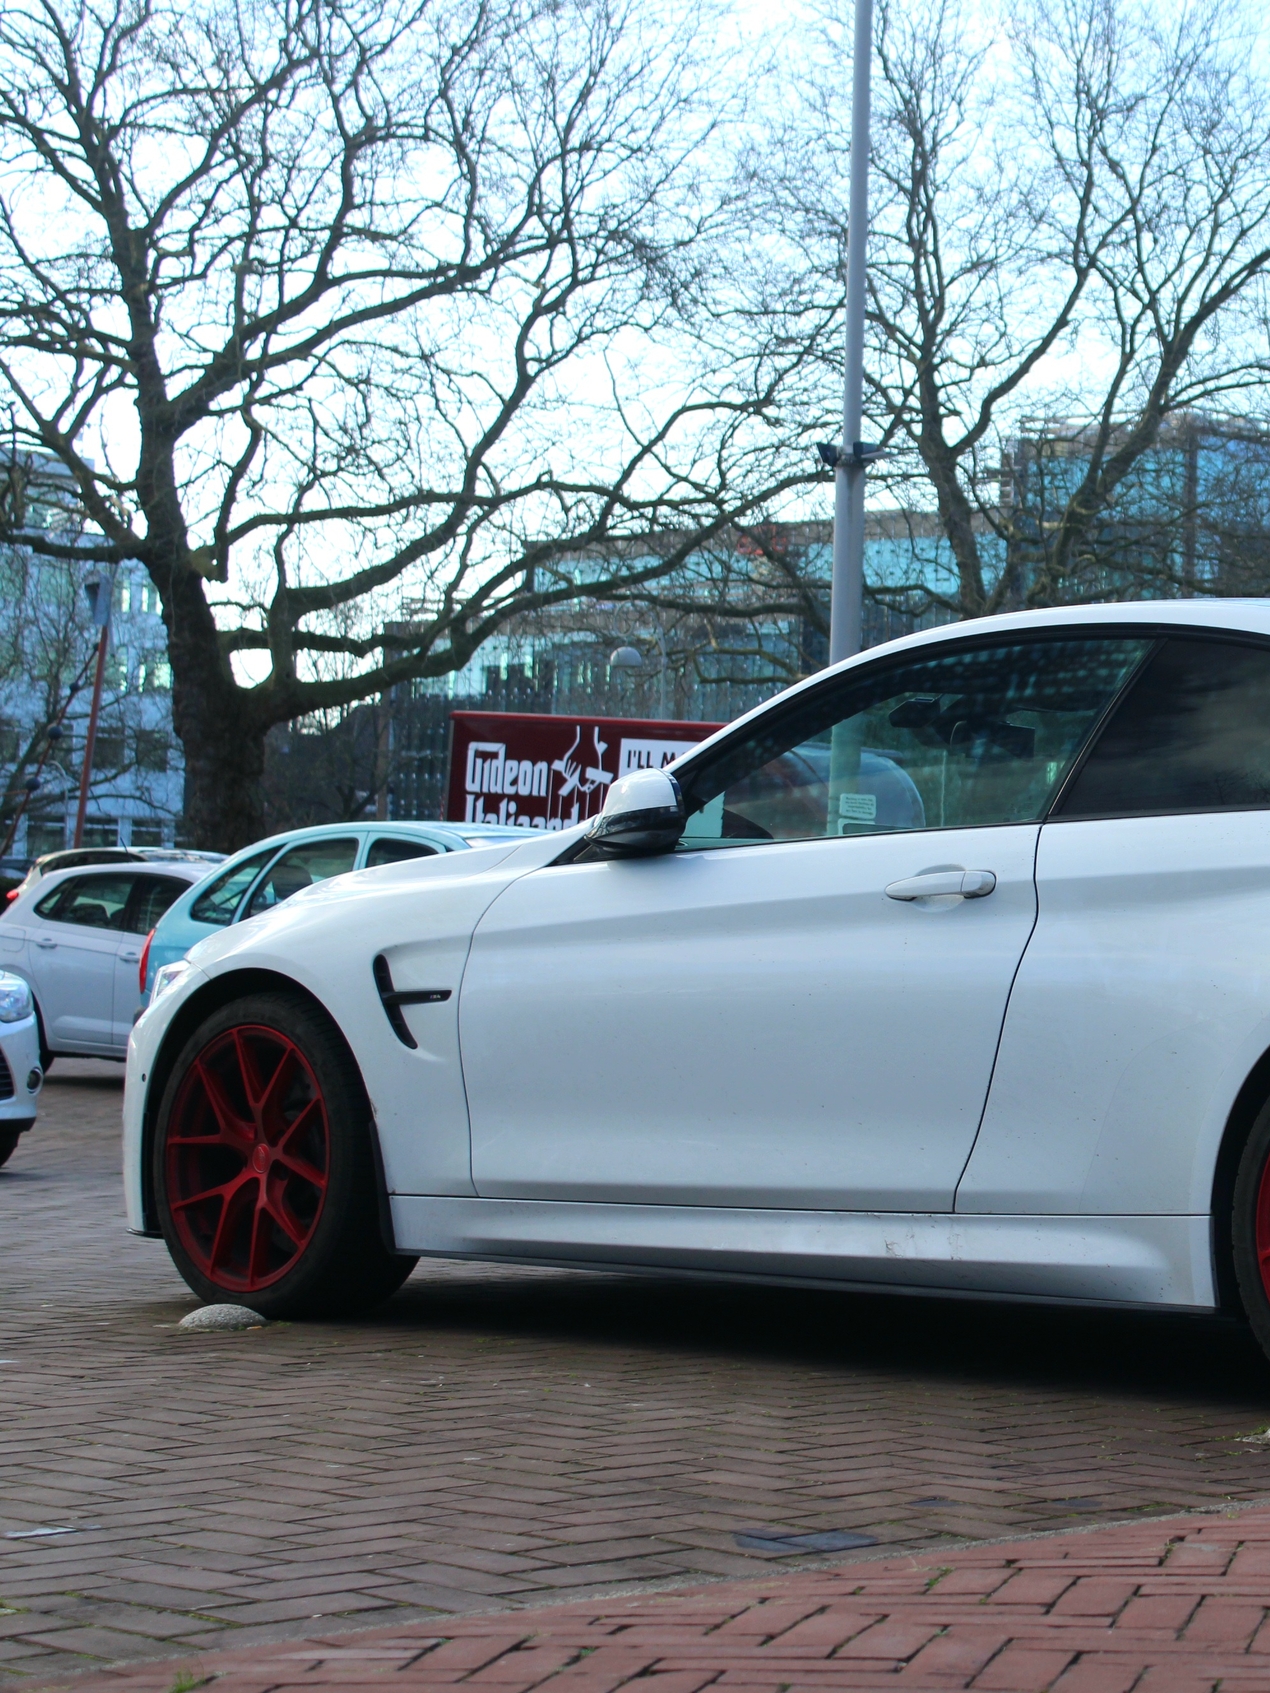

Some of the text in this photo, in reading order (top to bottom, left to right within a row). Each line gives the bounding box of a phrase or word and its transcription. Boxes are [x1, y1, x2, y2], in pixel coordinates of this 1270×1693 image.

[465, 741, 548, 797] Gideon
[626, 749, 686, 769] I'LL M
